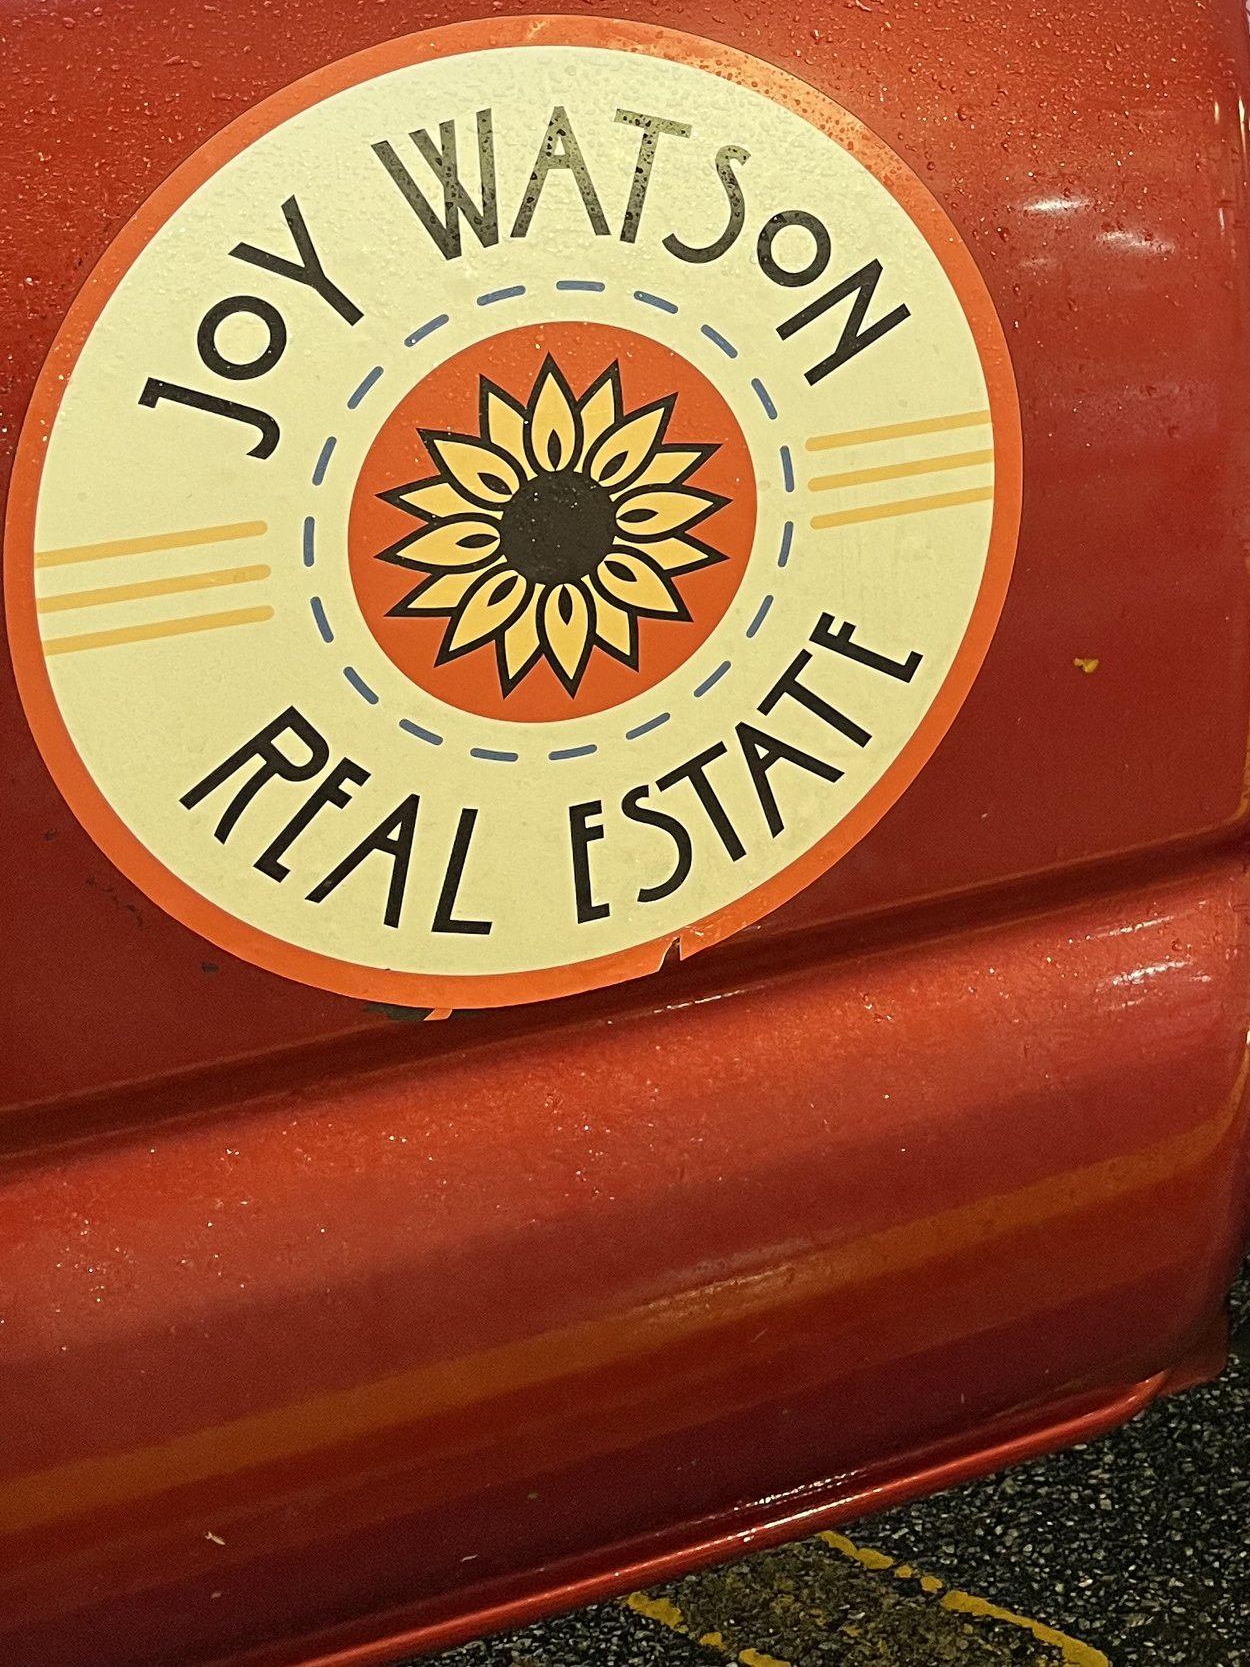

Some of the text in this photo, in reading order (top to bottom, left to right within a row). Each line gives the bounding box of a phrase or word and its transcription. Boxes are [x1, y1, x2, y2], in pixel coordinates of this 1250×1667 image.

[138, 106, 911, 459] JOY WATSON
[179, 612, 923, 934] REAL ESTATE
